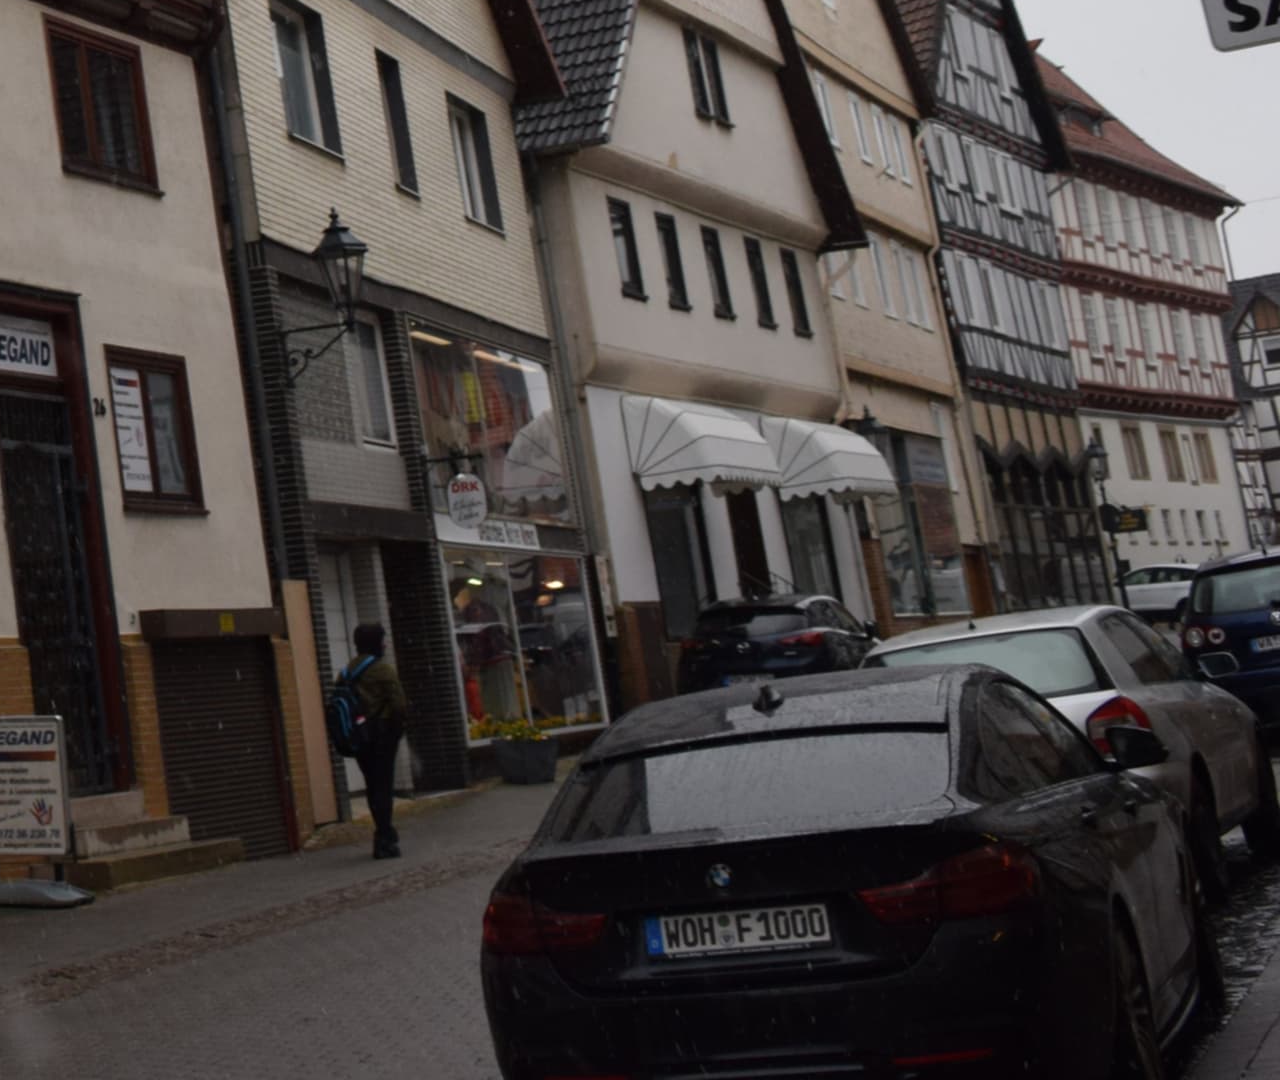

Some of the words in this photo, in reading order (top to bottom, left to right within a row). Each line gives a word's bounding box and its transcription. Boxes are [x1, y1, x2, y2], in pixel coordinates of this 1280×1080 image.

[93, 397, 107, 418] 26
[451, 481, 480, 493] DRK
[663, 916, 716, 950] WOH
